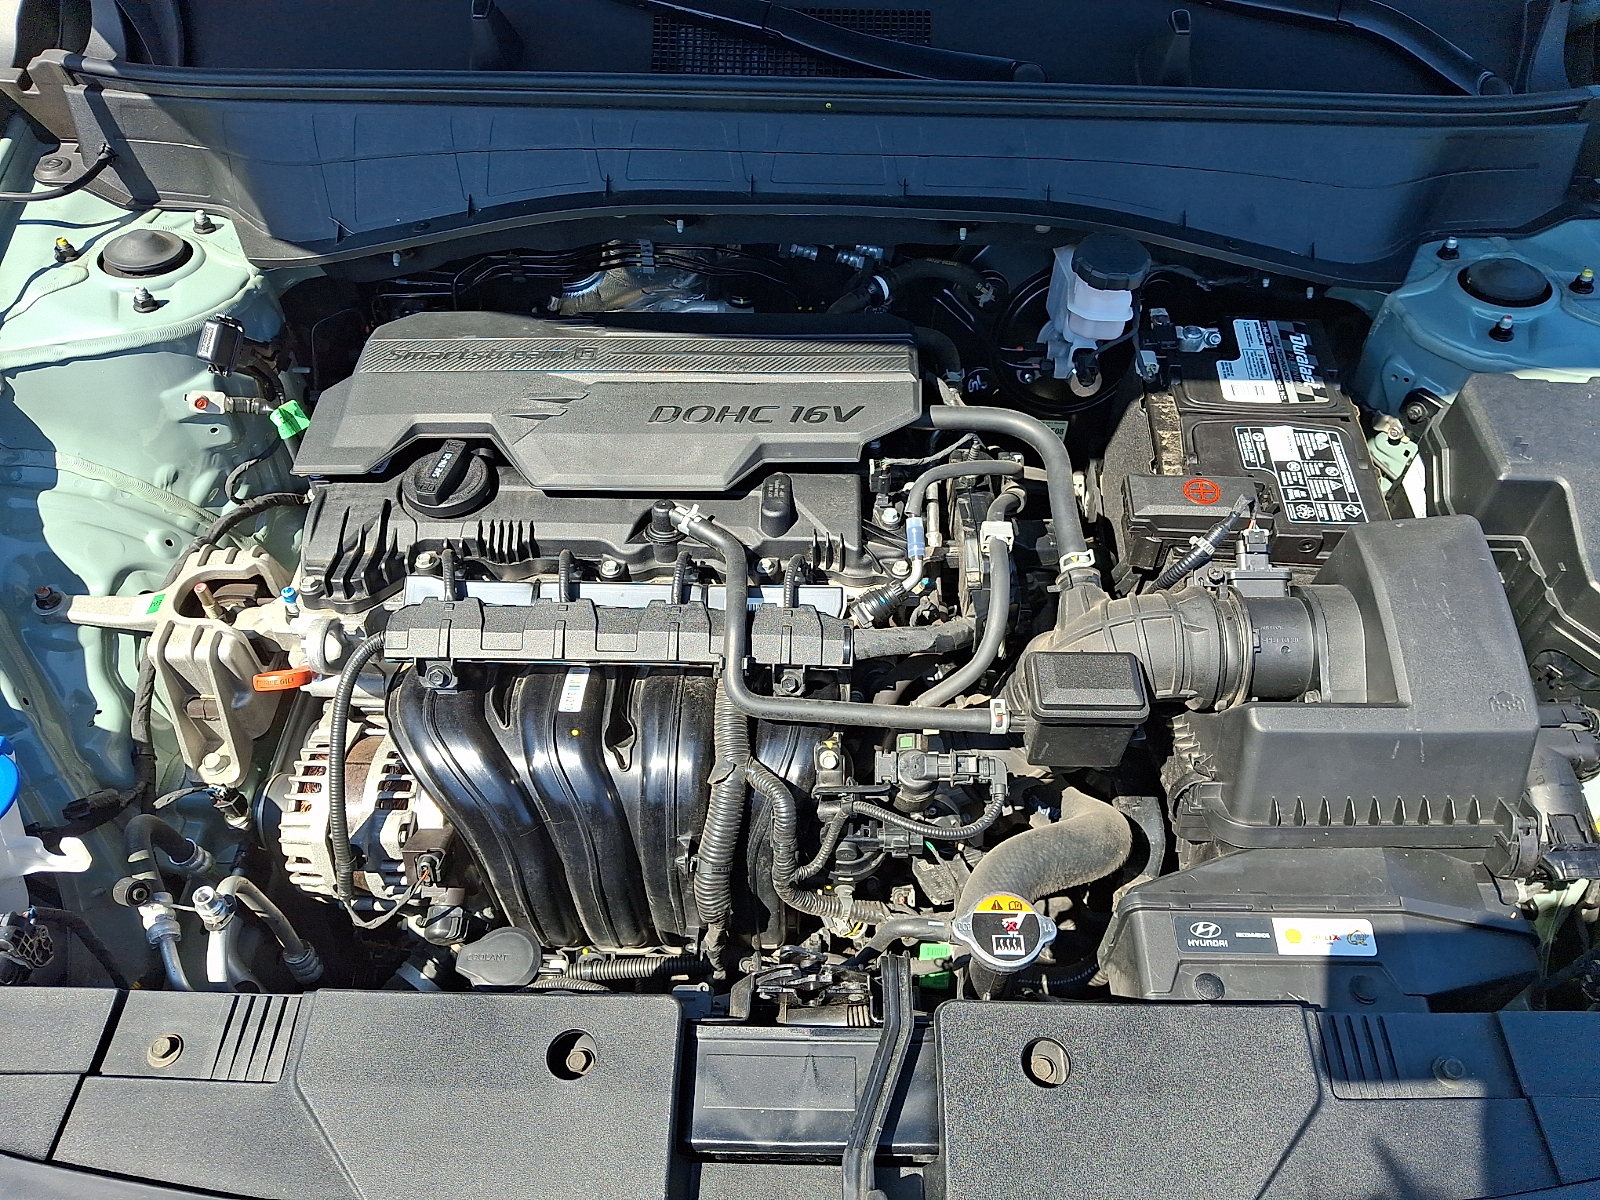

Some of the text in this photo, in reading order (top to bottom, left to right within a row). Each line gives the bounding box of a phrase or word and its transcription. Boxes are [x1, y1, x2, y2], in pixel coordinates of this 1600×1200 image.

[1289, 334, 1321, 389] Duralast
[647, 405, 865, 424] DOHC 16V
[1187, 939, 1229, 948] HYUNDAI
[466, 953, 510, 961] COOLANT
